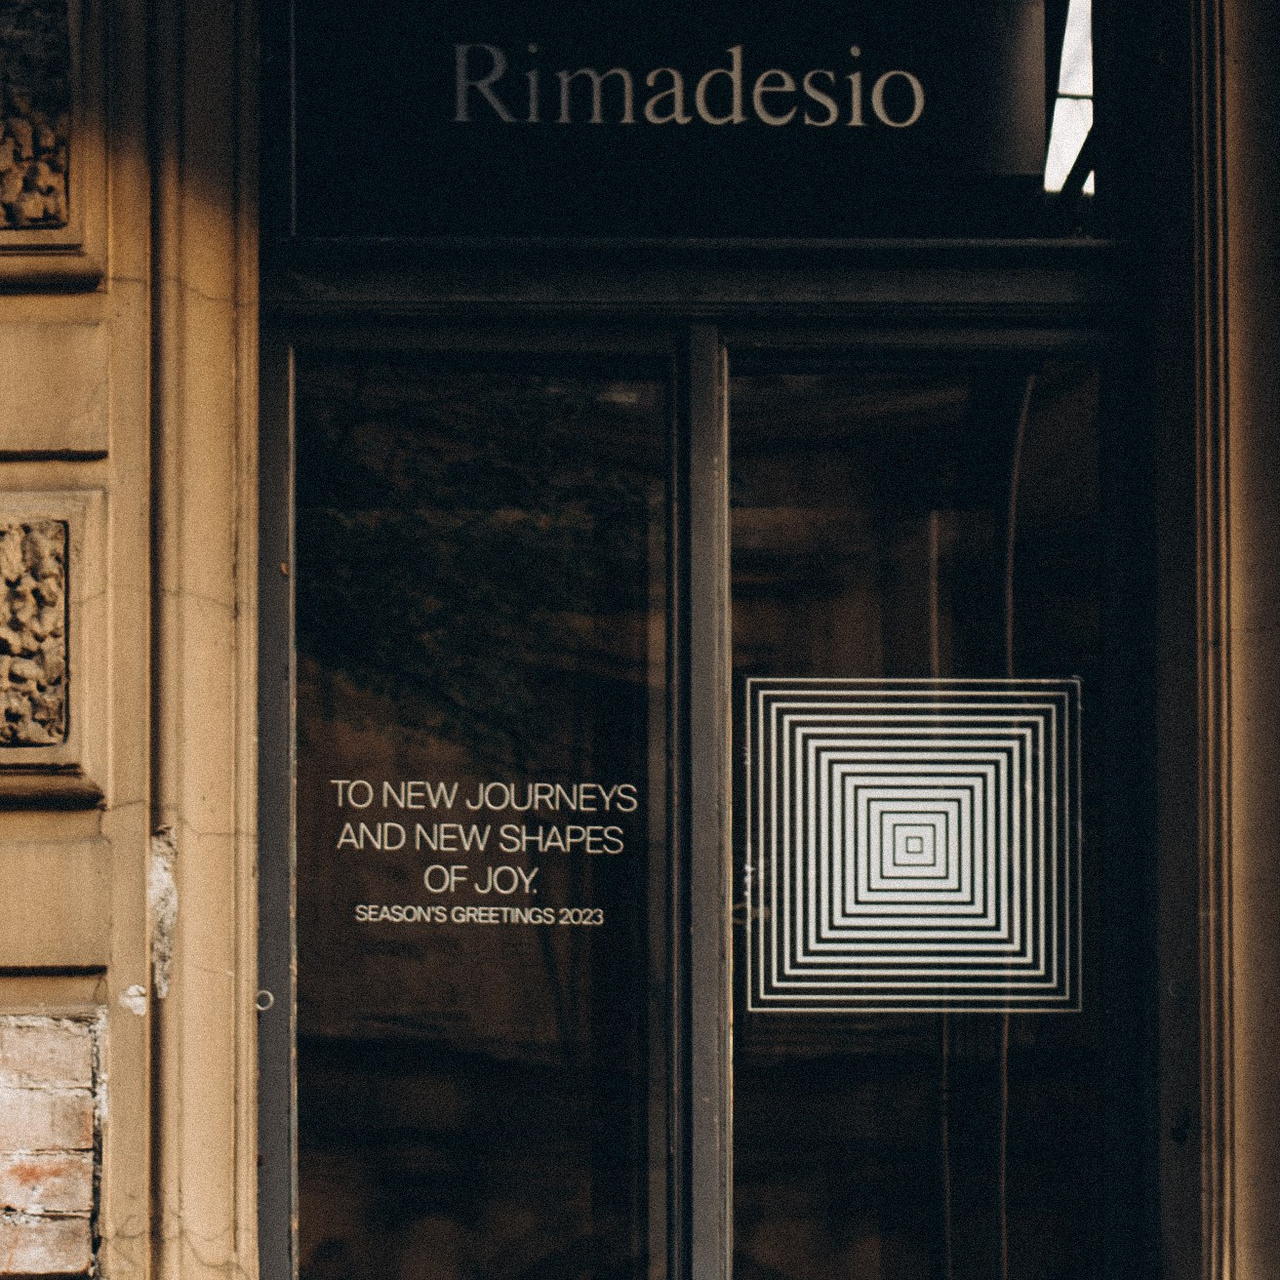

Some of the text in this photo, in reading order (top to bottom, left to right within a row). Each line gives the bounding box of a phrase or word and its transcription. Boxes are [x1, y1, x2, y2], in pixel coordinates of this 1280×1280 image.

[451, 43, 927, 128] Rimadesio
[330, 779, 638, 813] TO NEW JOURNEYS
[336, 822, 625, 855] AND NEW SHAPES
[423, 864, 540, 895] OF JOY.
[354, 904, 605, 926] SEASON'S GREETINGS 2023
